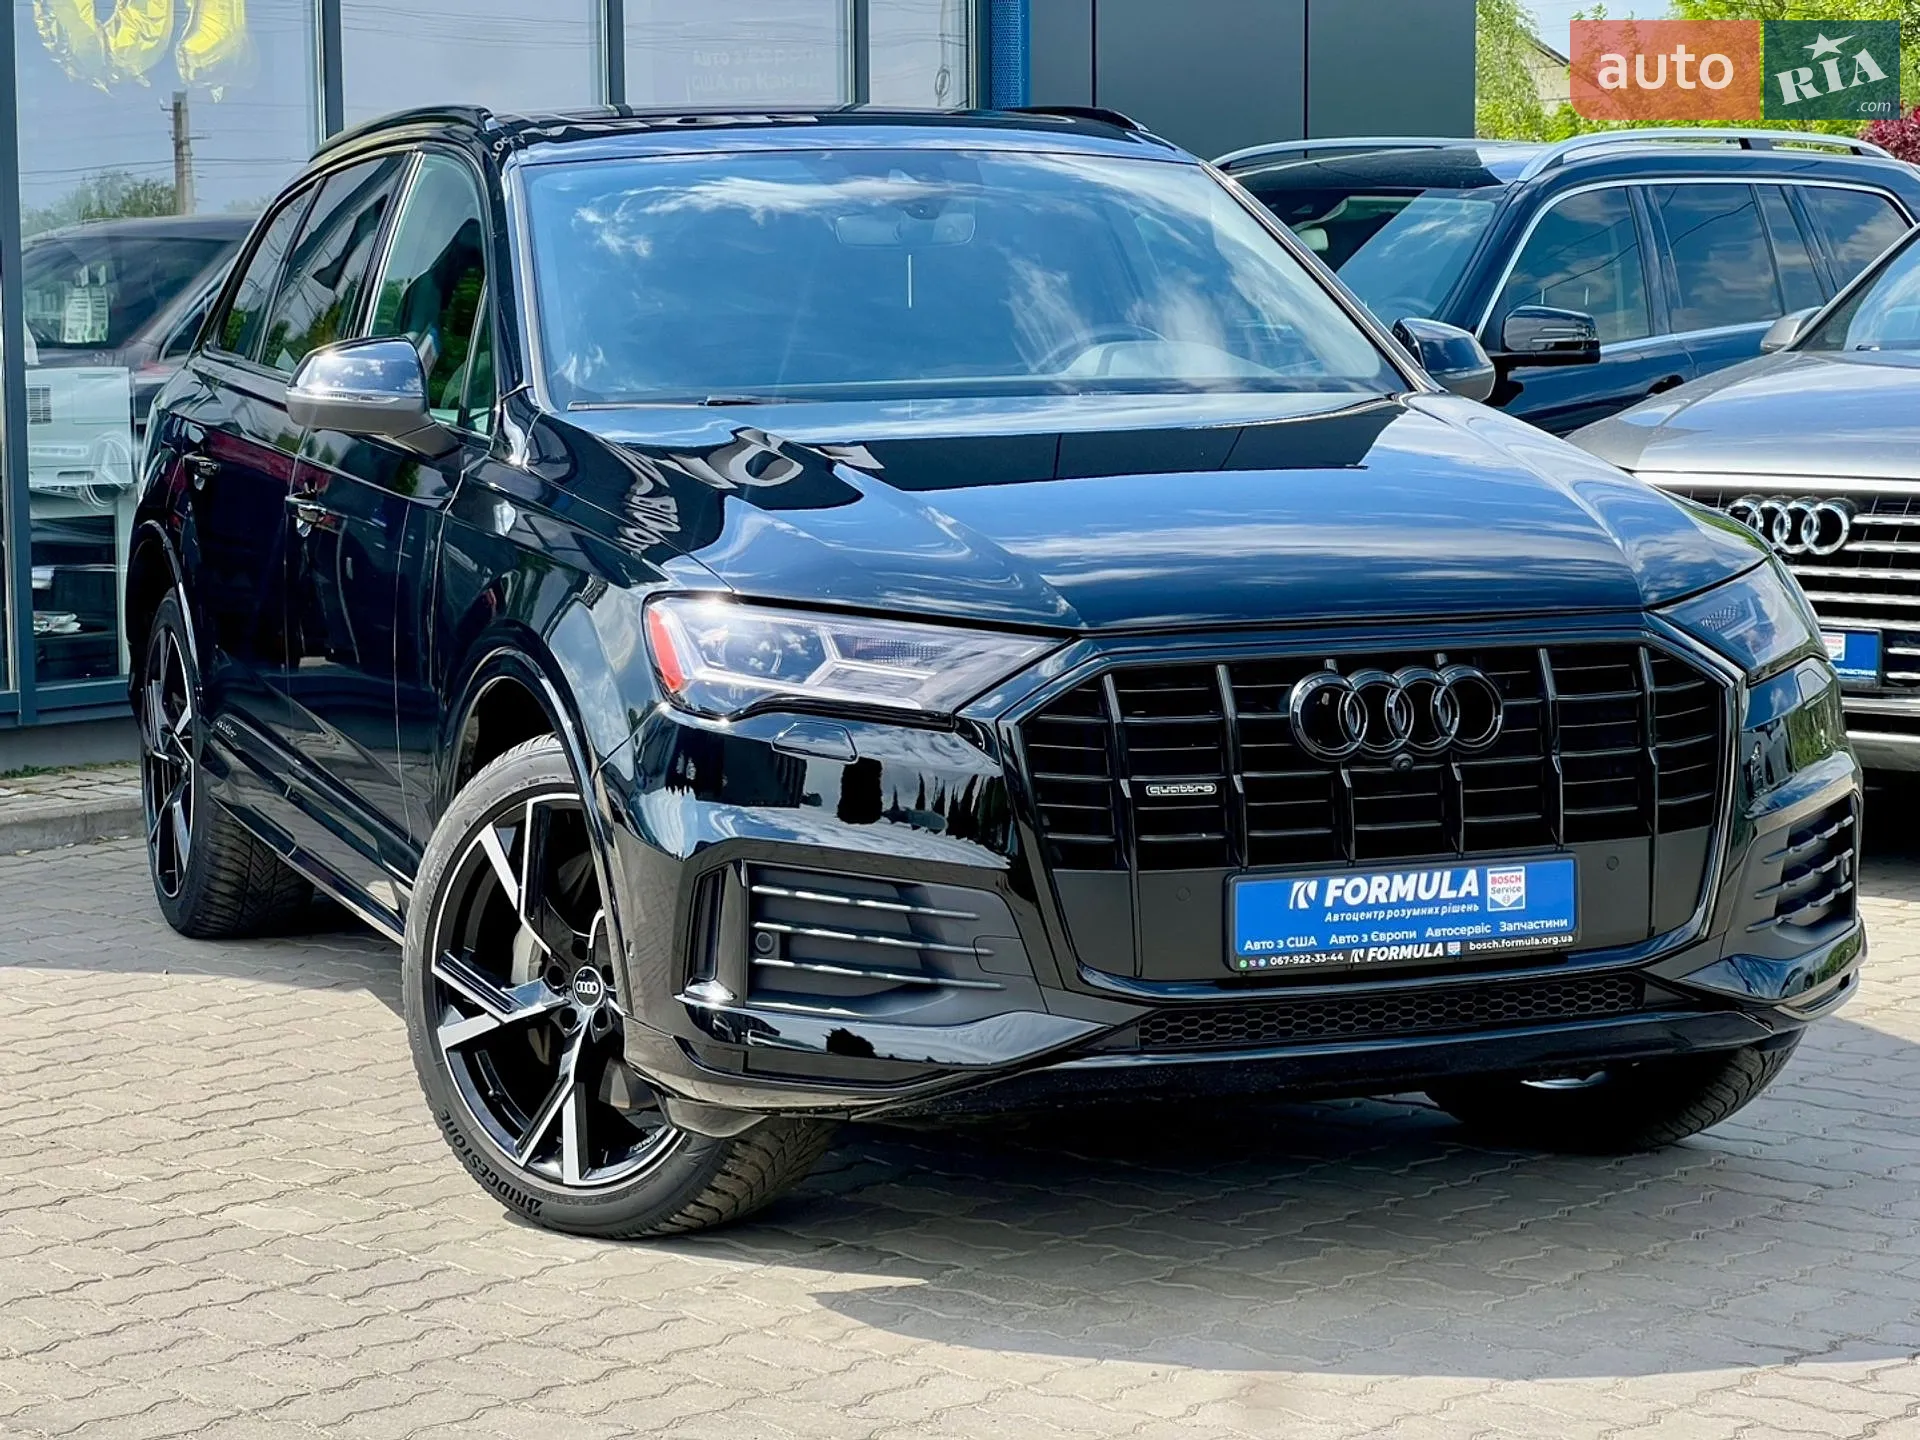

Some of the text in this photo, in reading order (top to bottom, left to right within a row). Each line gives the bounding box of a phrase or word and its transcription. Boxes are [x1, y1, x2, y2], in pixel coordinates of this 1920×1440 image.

[1150, 785, 1214, 796] quattro
[1325, 870, 1479, 907] FORMULA
[1491, 874, 1522, 885] BOSCH
[1491, 886, 1522, 895] Service
[1325, 903, 1479, 923] Автоцентр розумних рішень
[1244, 918, 1568, 951] Авто з США Авто з Європи Автосервіс Запчастини
[1270, 953, 1345, 966] 067-922-33-44
[1367, 943, 1443, 962] FORMULA
[1469, 935, 1573, 950] bosch.formula.org.ua
[438, 1105, 544, 1217] BRIDGESTONE
